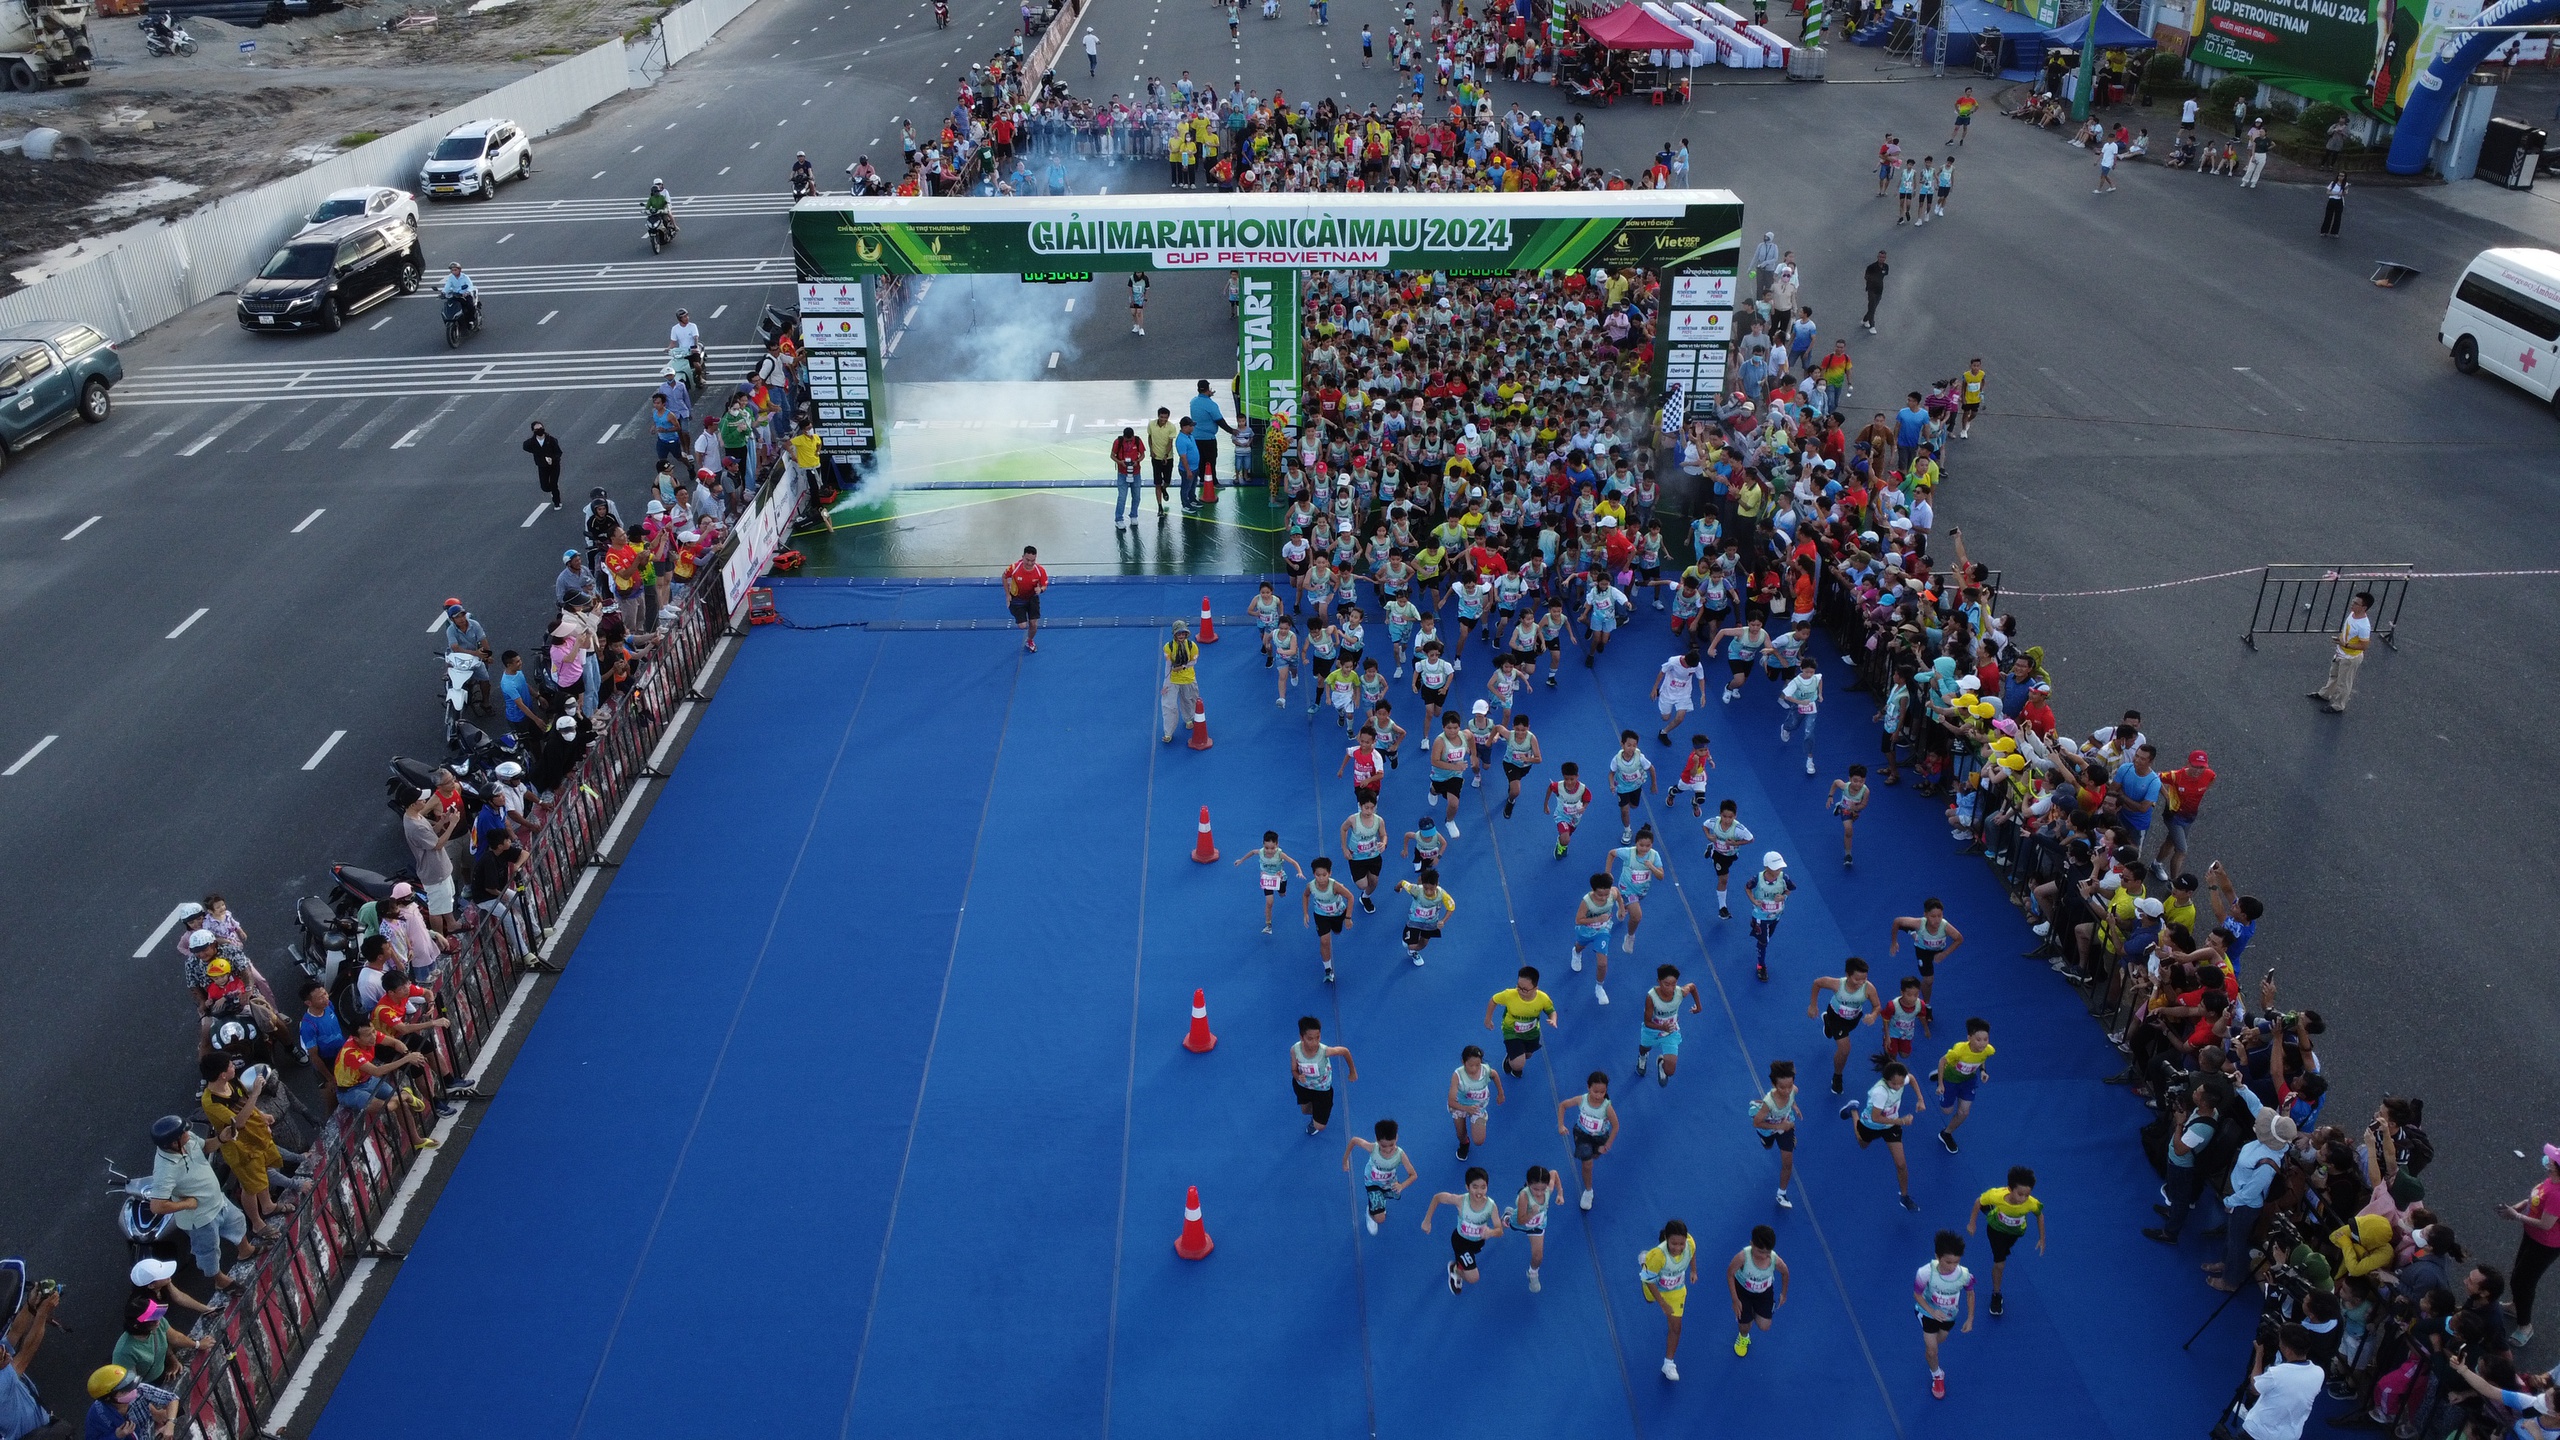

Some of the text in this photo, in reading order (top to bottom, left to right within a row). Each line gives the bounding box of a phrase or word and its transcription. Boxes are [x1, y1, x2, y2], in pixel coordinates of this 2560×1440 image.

[2211, 0, 2310, 35] CUP PETROVIETNAM
[2311, 0, 2337, 18] MAU
[2338, 5, 2367, 25] 2024
[2205, 32, 2236, 46] RACE DATE
[2203, 39, 2254, 65] 10.11.2024
[1031, 212, 1509, 251] GIẢI MARATHON CÀ MAU 2024
[1655, 235, 1684, 249] Viet
[1167, 251, 1378, 264] CUP PETROVIETNAM
[1243, 276, 1273, 371] START
[1601, 940, 1607, 949] 9
[1459, 1251, 1474, 1267] 16
